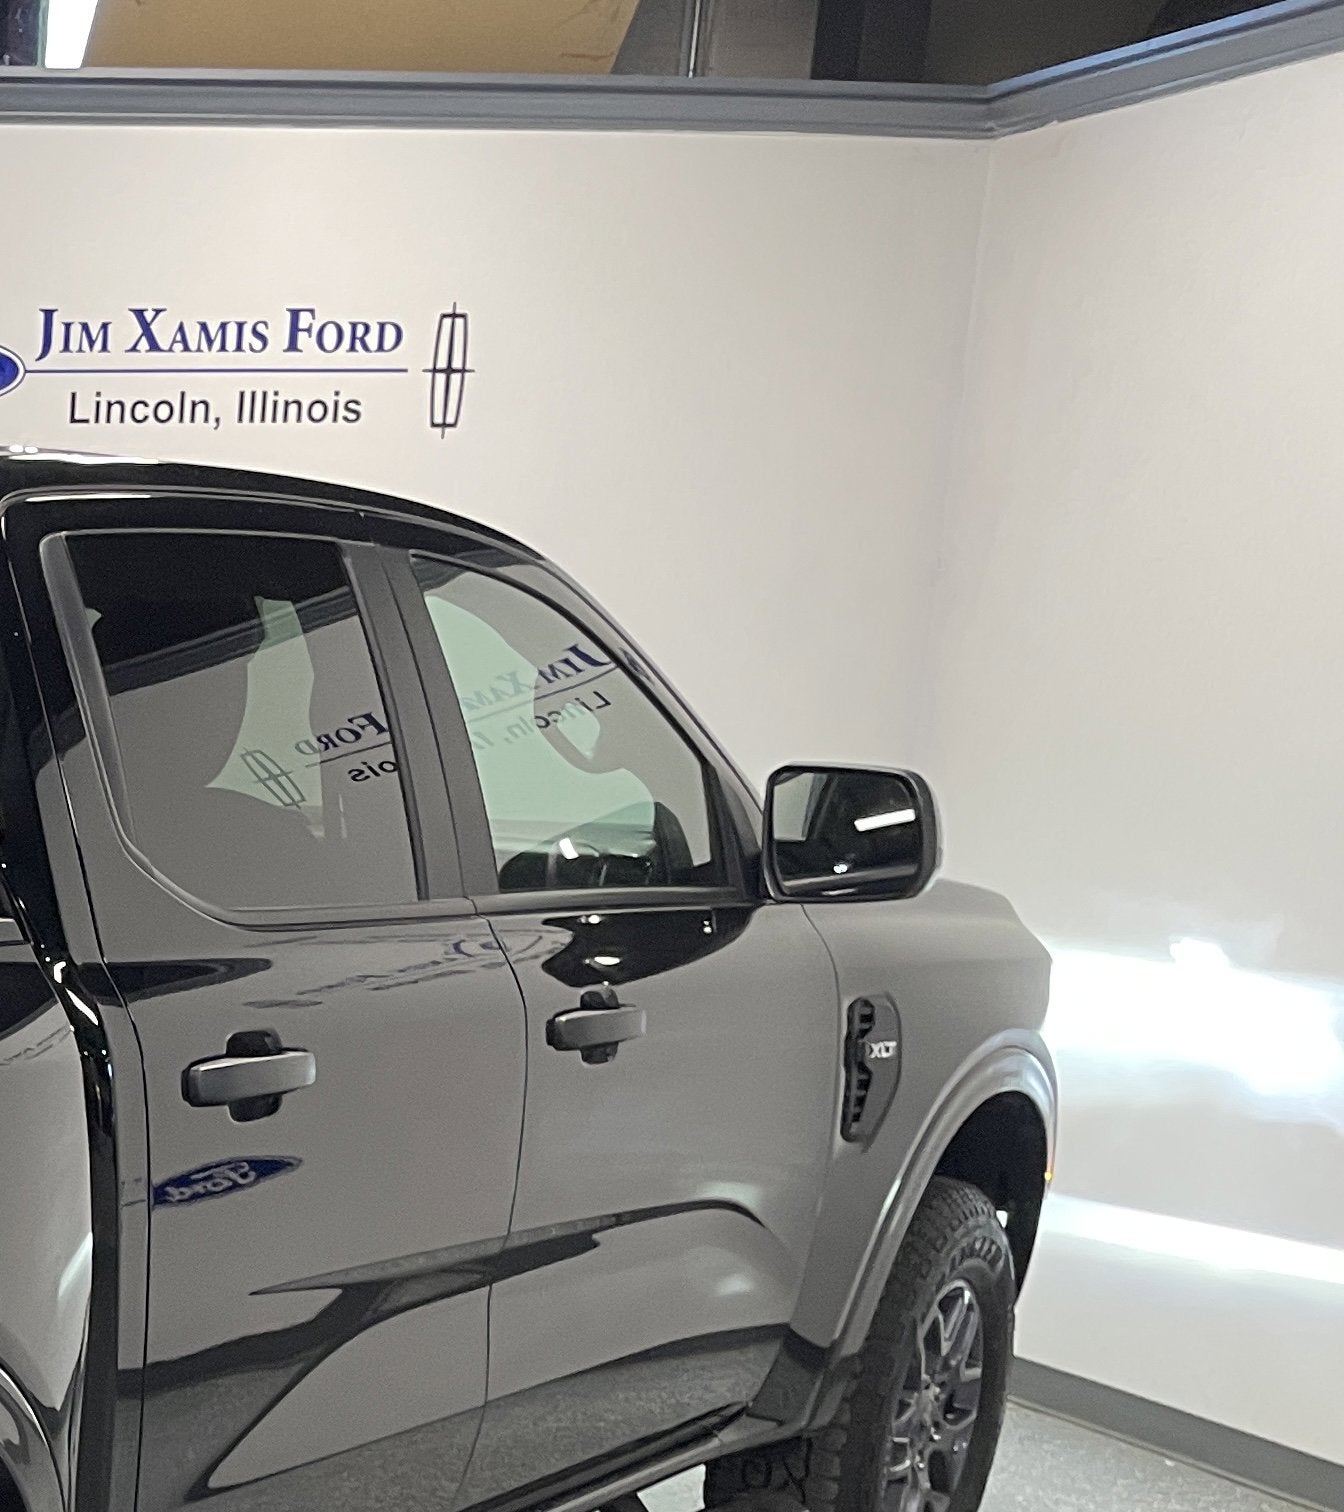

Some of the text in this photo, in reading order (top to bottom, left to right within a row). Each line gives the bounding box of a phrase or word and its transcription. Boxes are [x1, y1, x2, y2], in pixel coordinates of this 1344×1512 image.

[36, 308, 403, 362] JIM XAMIS FORD
[69, 391, 362, 430] Lincoln, Illinois
[870, 1040, 898, 1058] XLT
